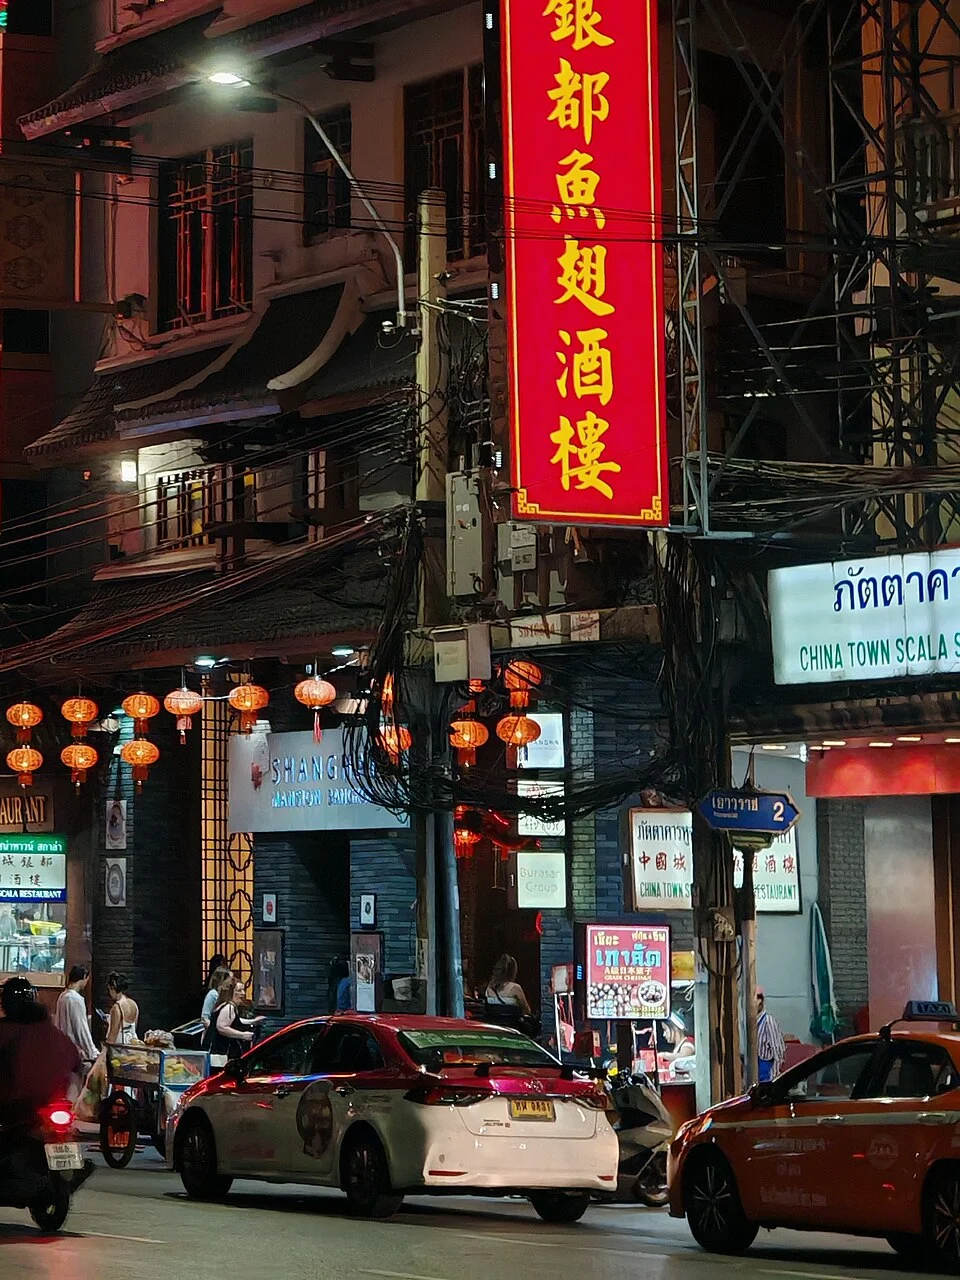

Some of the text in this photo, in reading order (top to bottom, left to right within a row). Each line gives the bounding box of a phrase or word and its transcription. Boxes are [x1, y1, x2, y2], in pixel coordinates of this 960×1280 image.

[800, 643, 844, 671] CHINA
[848, 638, 890, 667] TOWN
[895, 633, 948, 663] SCALA
[772, 801, 785, 822] 2
[638, 851, 687, 871] 中國城
[20, 890, 62, 899] RESTAURANT
[525, 881, 558, 894] Group
[640, 882, 661, 898] CHINA
[663, 882, 683, 898] TOWN
